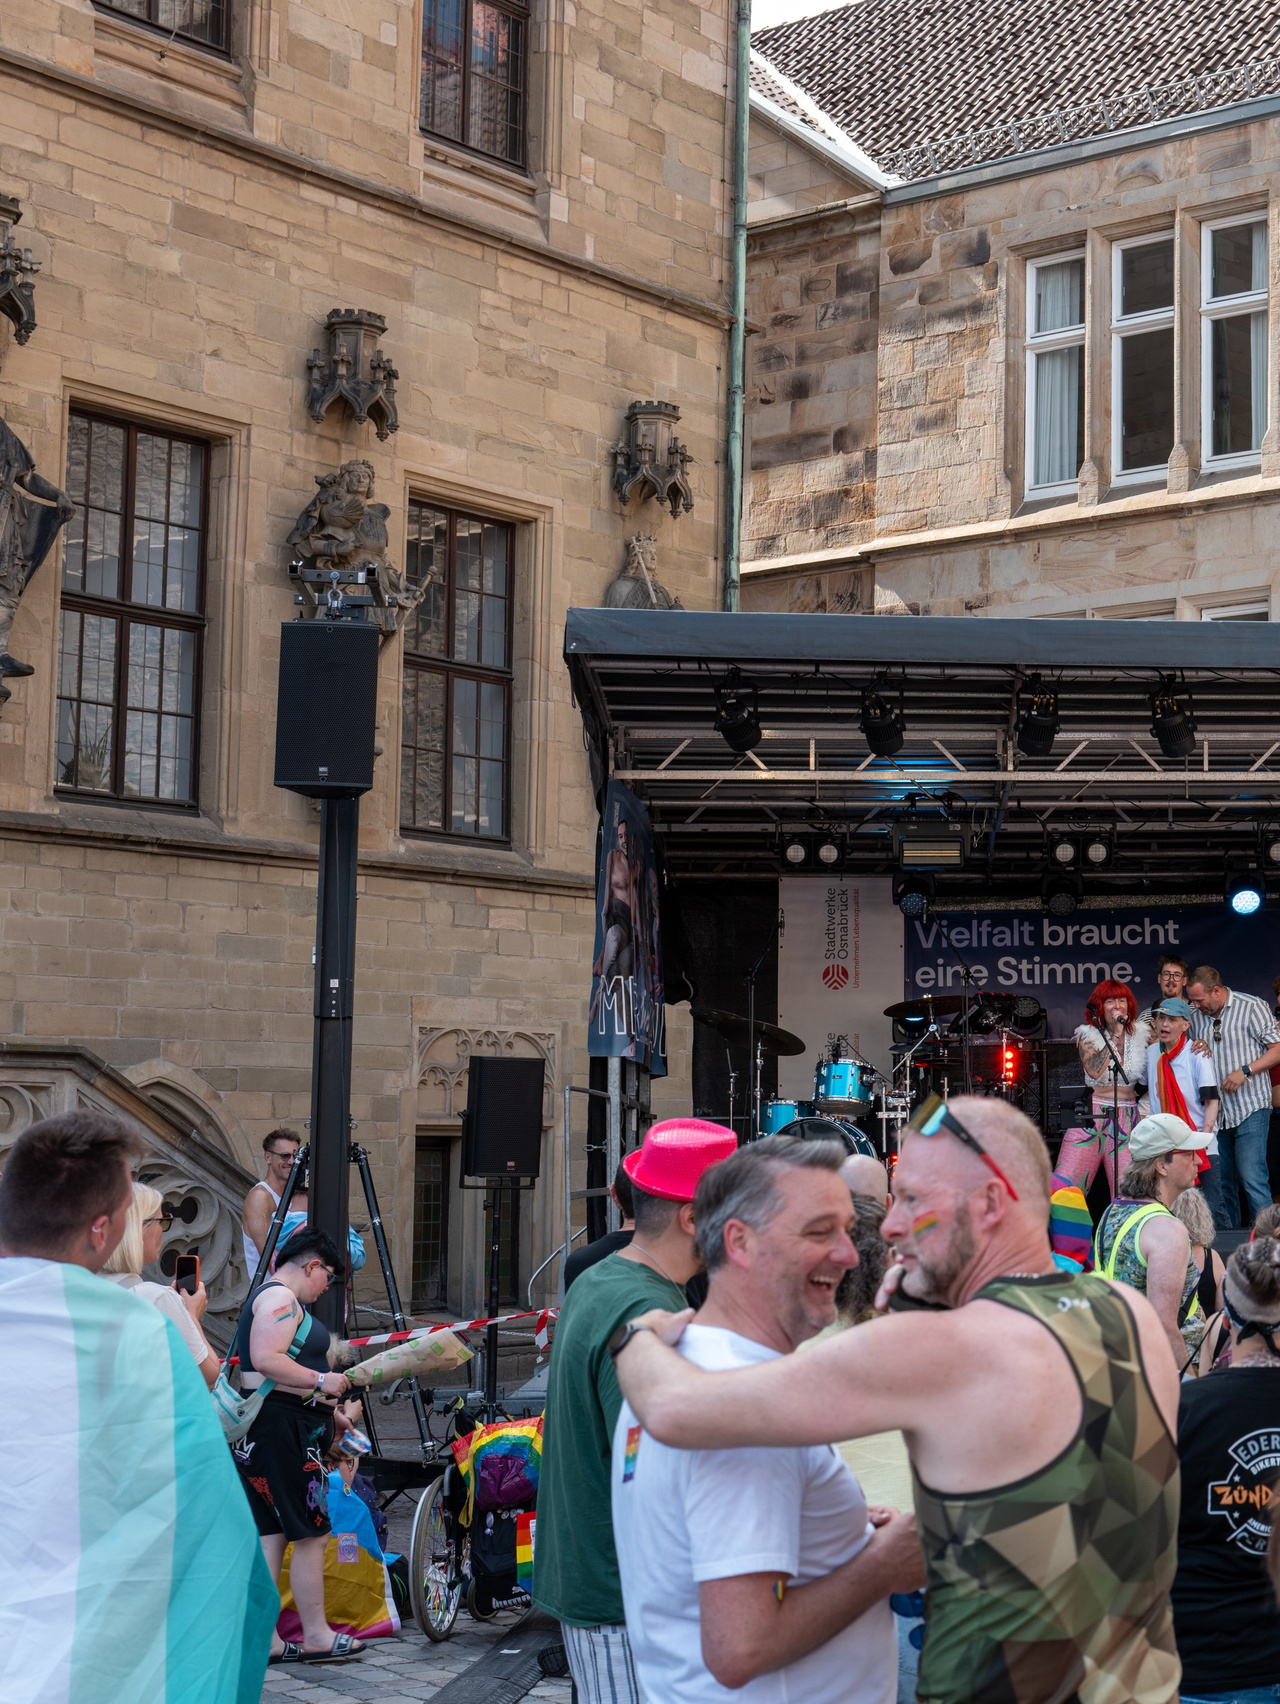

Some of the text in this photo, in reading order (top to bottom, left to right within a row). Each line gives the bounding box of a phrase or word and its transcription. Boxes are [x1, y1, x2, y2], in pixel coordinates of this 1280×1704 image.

[825, 888, 836, 960] Stadtwerke
[837, 888, 849, 960] Osnabrück
[853, 888, 861, 939] Lebensqualität
[914, 917, 1180, 949] Vielfalt braucht
[915, 955, 1141, 988] eine Stimme.
[1247, 1517, 1274, 1533] AMERIC
